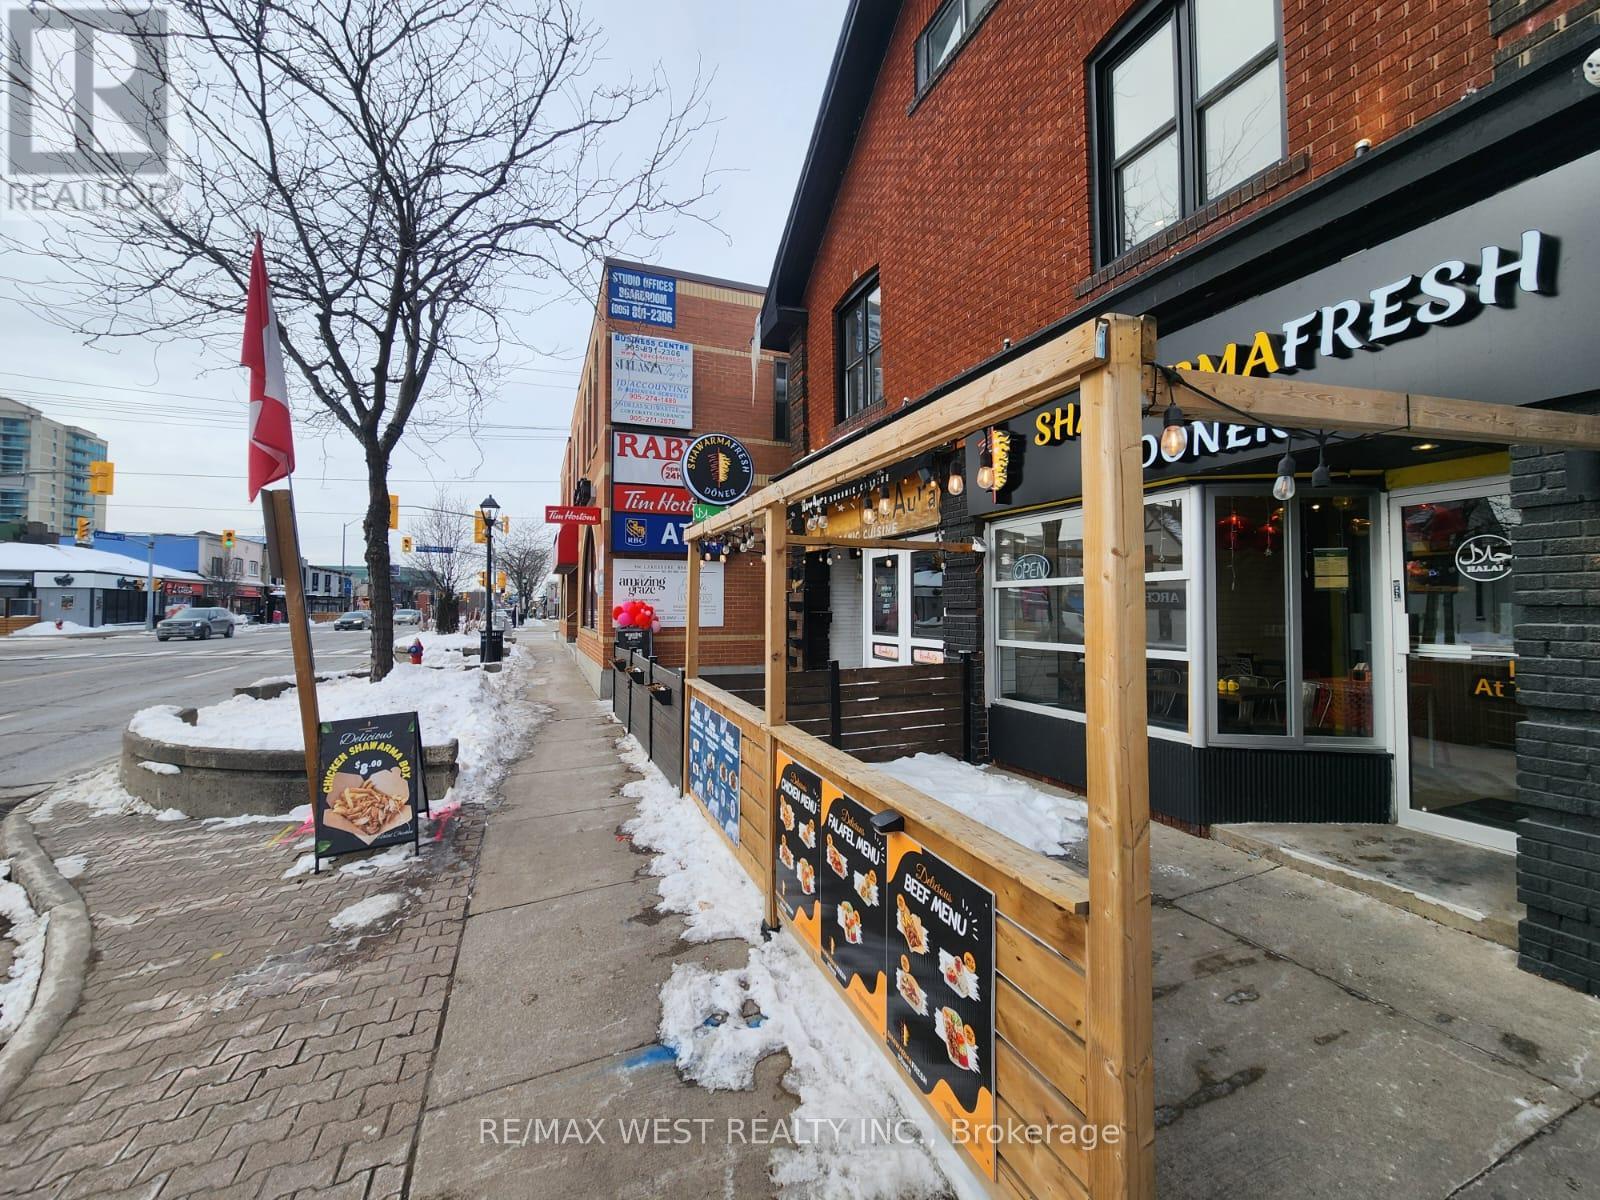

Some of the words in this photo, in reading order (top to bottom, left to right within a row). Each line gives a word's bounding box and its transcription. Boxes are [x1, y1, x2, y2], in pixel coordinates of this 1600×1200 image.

[612, 272, 641, 287] STUDIO
[643, 277, 674, 293] OFFICES
[658, 341, 690, 352] CENTRE
[617, 433, 691, 461] RAB
[688, 436, 750, 473] SHAWARMAFRESH
[624, 490, 654, 509] Tim
[548, 510, 564, 520] Tim
[566, 511, 596, 521] Hortons
[627, 536, 644, 544] RBC
[1013, 563, 1047, 580] OPEN
[618, 575, 667, 591] amazing
[628, 586, 656, 598] graze
[340, 730, 394, 745] Delicious
[323, 752, 348, 794] CHICKEN
[348, 741, 404, 761] SHAWARMA
[399, 760, 411, 779] BOX
[799, 792, 817, 815] MENU
[827, 813, 855, 848] FALAFEL
[855, 834, 881, 867] MENU
[915, 863, 953, 903] Delicious
[903, 873, 931, 905] BEEF
[930, 895, 968, 937] MENU
